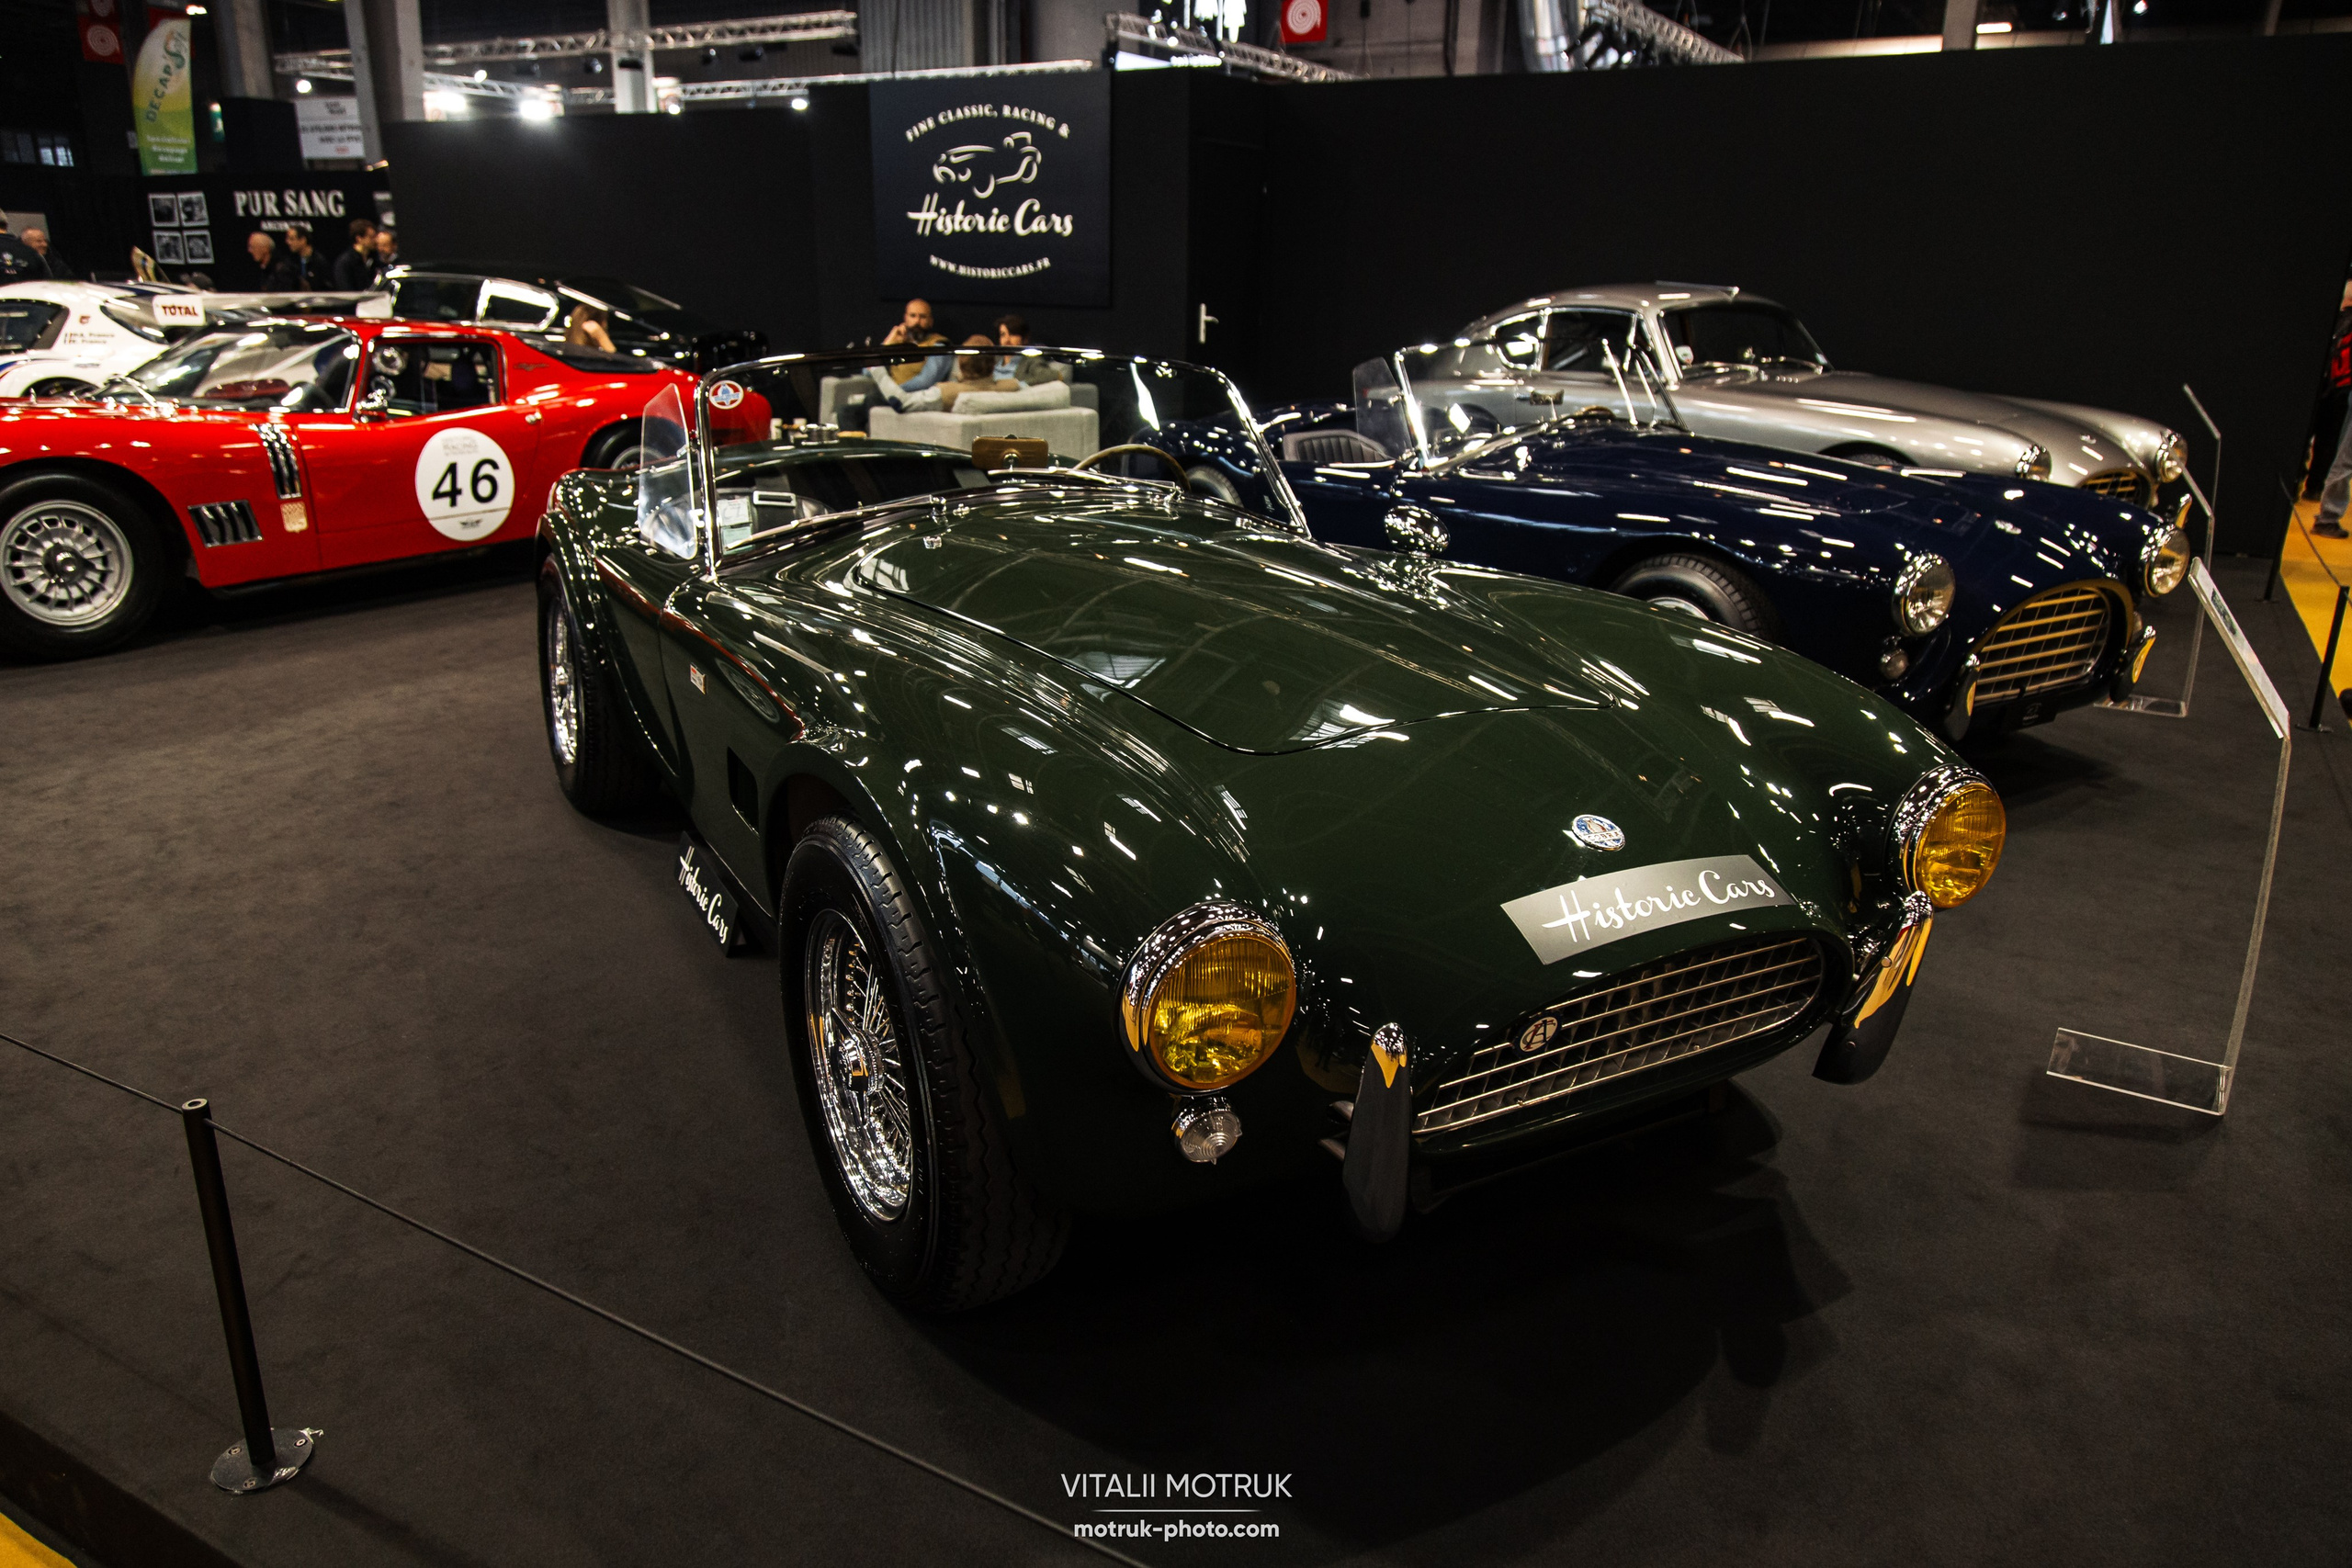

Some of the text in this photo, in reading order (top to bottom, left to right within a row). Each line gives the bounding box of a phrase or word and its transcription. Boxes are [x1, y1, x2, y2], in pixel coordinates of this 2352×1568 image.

[905, 103, 1070, 142] FINE CLASSIC, RACING &
[233, 189, 345, 218] PUR SANG
[907, 192, 1073, 237] Historic Cars
[929, 254, 1051, 279] WWW.HISTORICCARS.FR
[161, 305, 198, 317] TOTAL
[431, 457, 500, 507] 46
[678, 845, 729, 944] Historic Cars
[1541, 869, 1775, 943] Historic Cars
